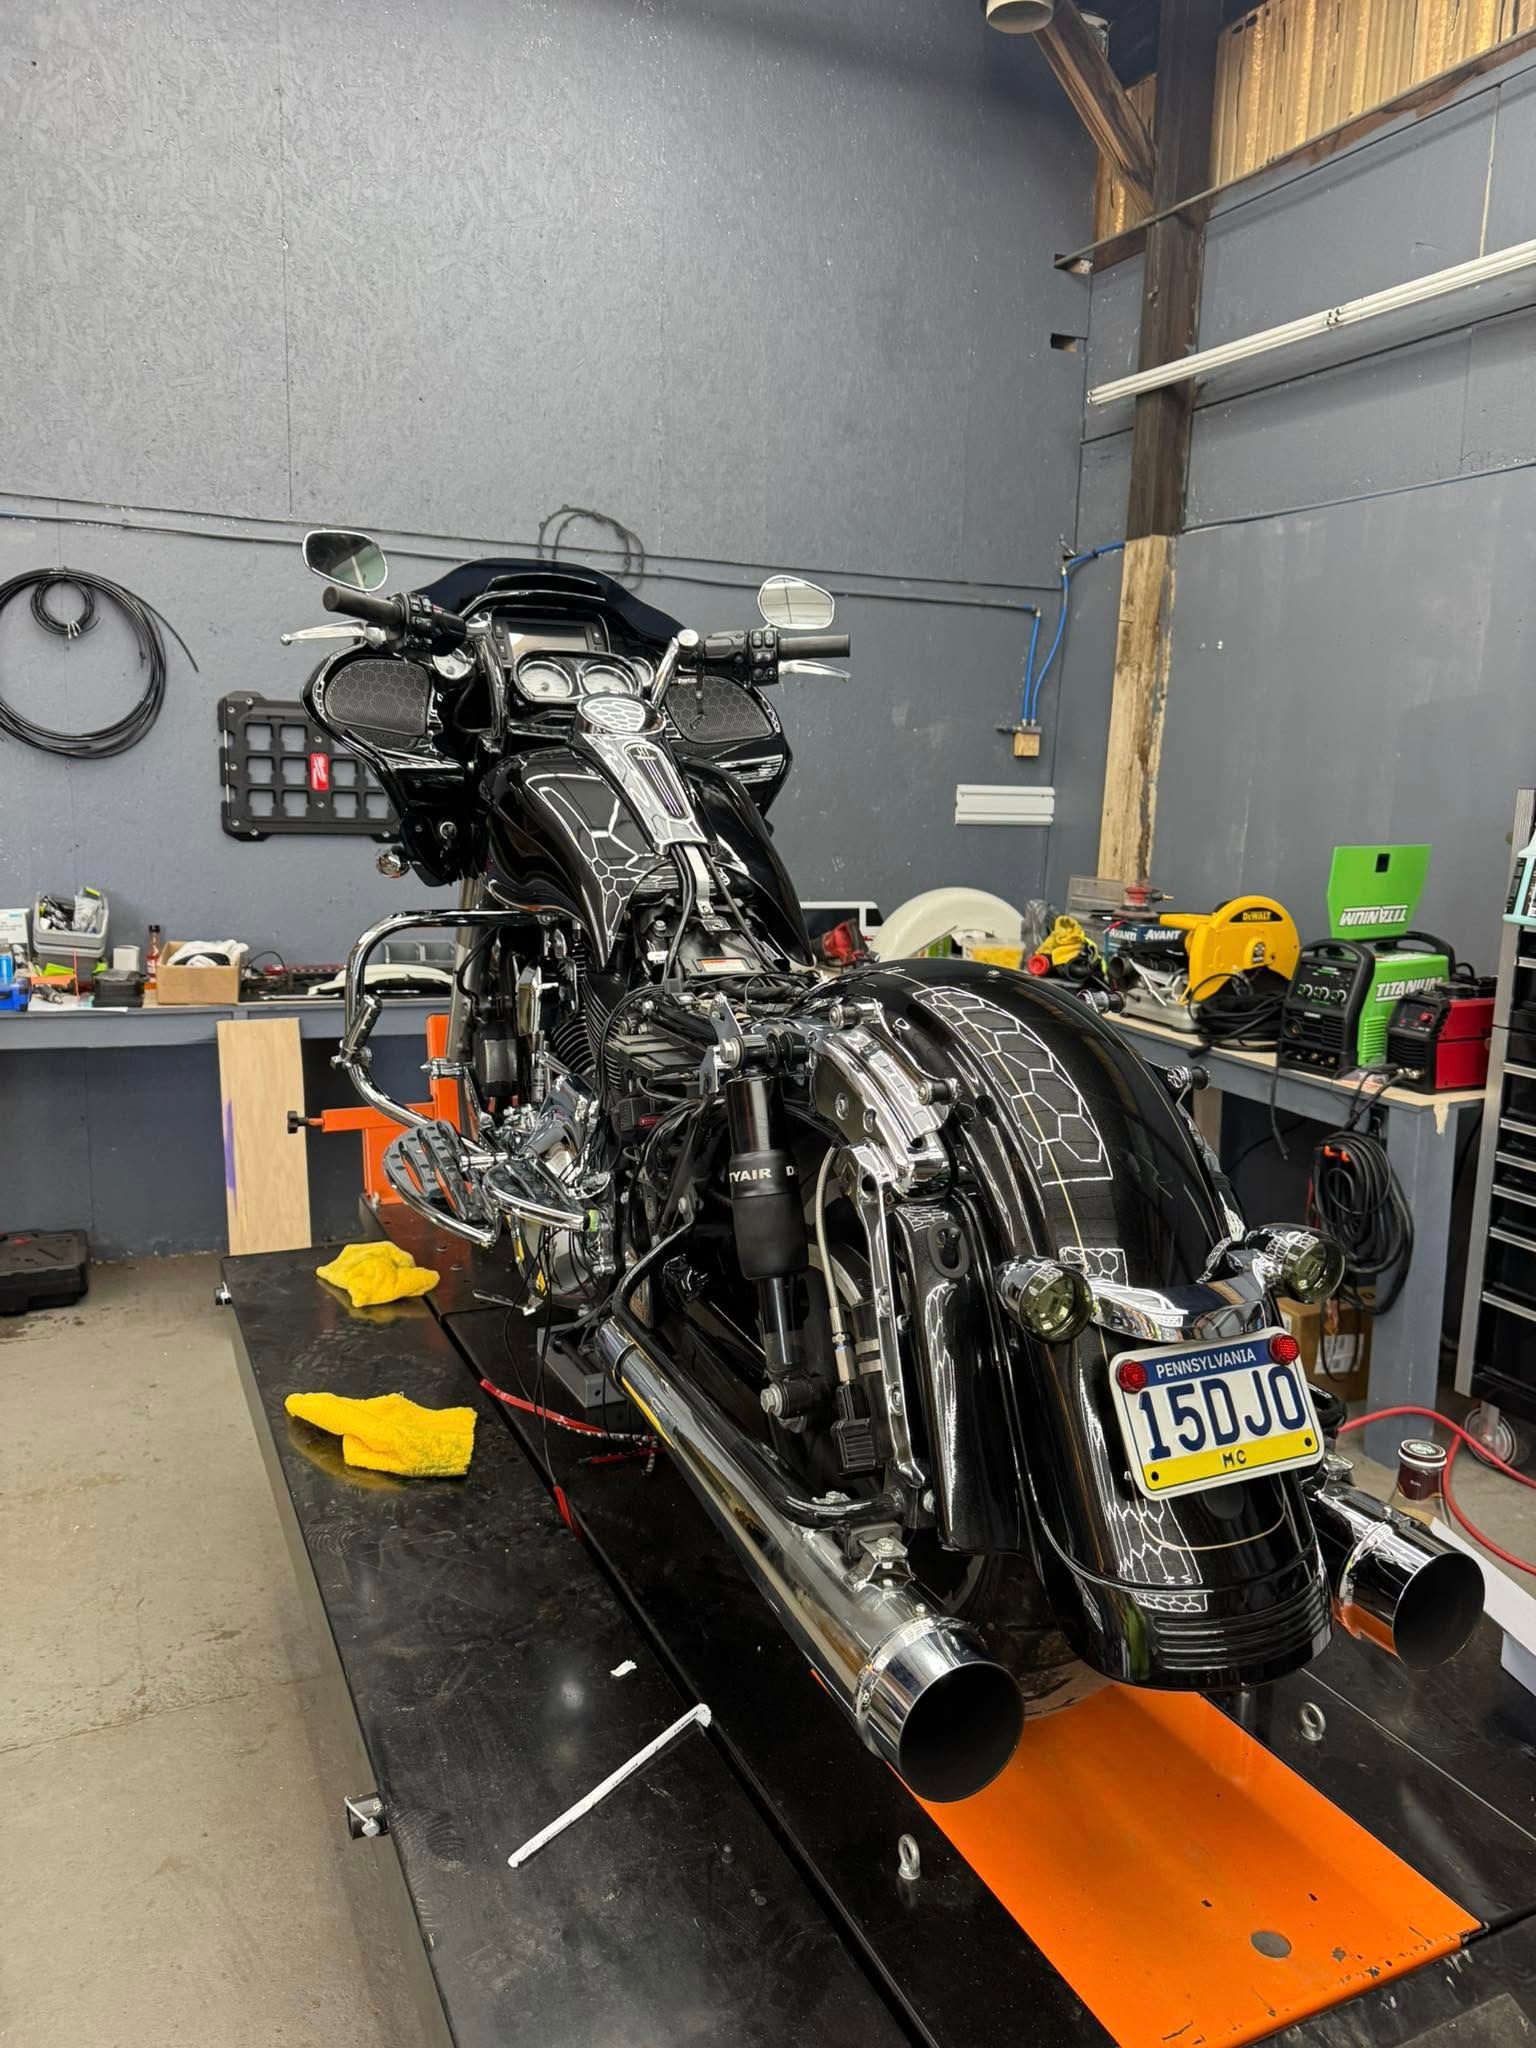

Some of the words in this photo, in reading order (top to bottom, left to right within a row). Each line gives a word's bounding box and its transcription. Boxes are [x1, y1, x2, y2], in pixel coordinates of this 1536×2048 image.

[1339, 905, 1408, 926] TITANIUM
[1156, 1348, 1256, 1379] PENNSYLVANIA
[1222, 1450, 1247, 1468] MC
